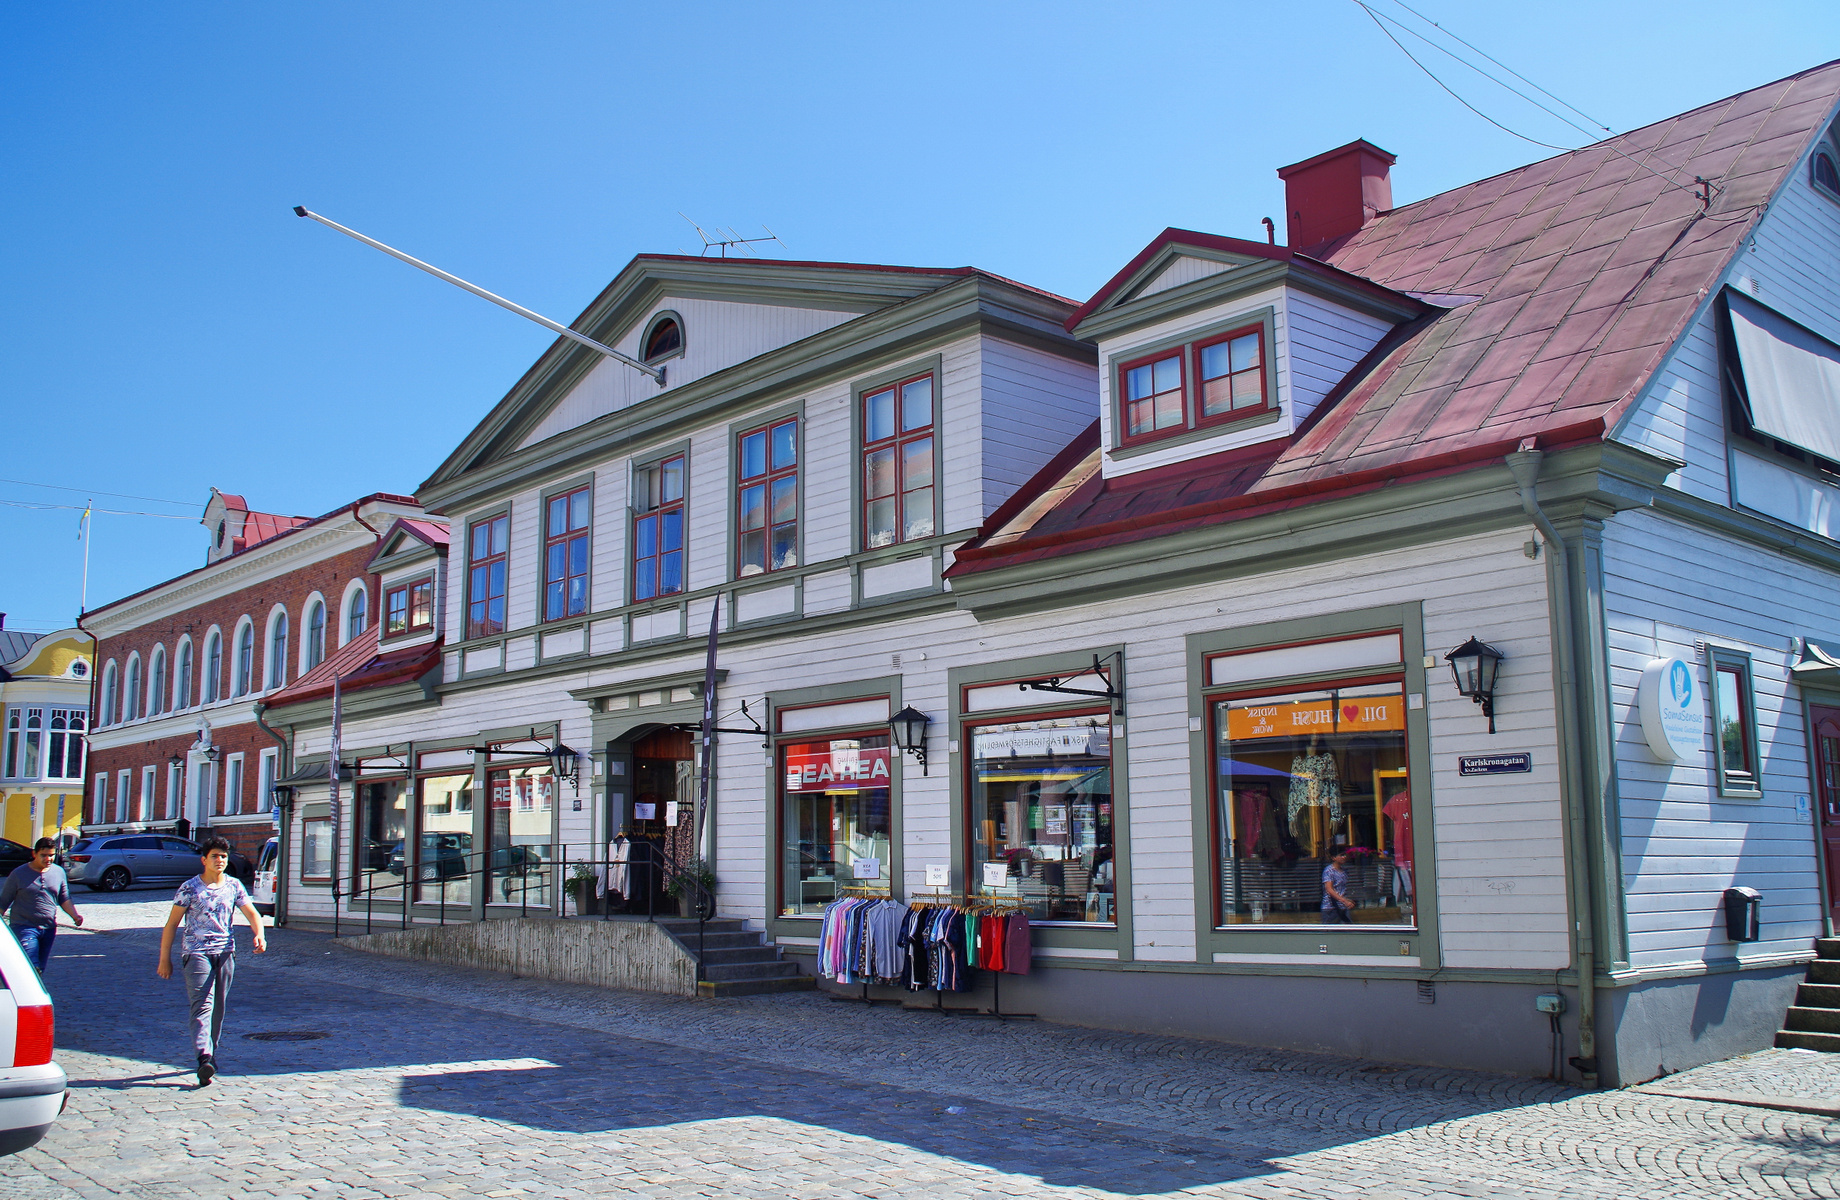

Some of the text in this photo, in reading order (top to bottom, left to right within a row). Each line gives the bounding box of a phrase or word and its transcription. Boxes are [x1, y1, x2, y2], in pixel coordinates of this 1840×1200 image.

[1663, 707, 1703, 723] SomaSensus
[787, 757, 890, 784] REA REA
[1464, 757, 1524, 768] Karlskronagatan
[493, 785, 522, 802] REA
